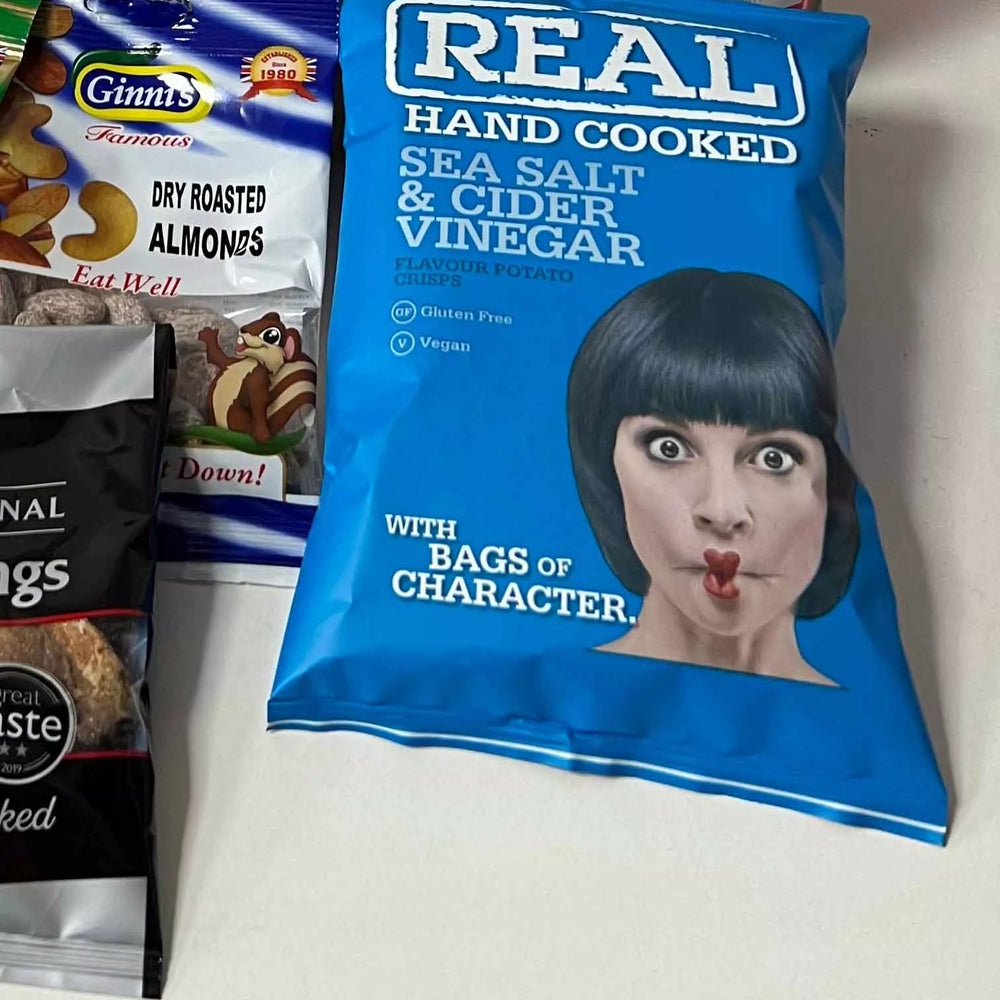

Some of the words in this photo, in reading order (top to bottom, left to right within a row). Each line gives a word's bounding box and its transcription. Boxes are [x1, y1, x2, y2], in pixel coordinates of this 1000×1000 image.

[260, 69, 297, 80] 1980
[414, 10, 777, 108] REAL
[86, 73, 195, 108] Ginnis
[84, 124, 193, 149] Famous
[403, 103, 560, 145] HAND
[574, 119, 798, 165] COOKED
[400, 145, 501, 184] SEA
[516, 155, 646, 196] SALT
[151, 181, 187, 209] DRY
[190, 182, 267, 215] ROASTED
[397, 180, 435, 213] &
[451, 184, 619, 229] CIDER
[148, 223, 266, 261] ALMONDS
[396, 215, 645, 268] VINEGAR
[71, 263, 115, 289] Eat
[121, 271, 183, 298] Well
[394, 257, 489, 276] FLAVOUR
[493, 262, 574, 284] POTATO
[394, 272, 463, 288] CRISPS
[420, 305, 475, 322] Gluten
[478, 310, 513, 326] Free
[419, 336, 471, 355] Vegan
[176, 456, 267, 487] Down!
[385, 513, 457, 540] WITH
[428, 543, 529, 575] BAGS
[537, 557, 572, 577] OF
[392, 570, 638, 624] CHARACTER.
[0, 763, 23, 774] 2019
